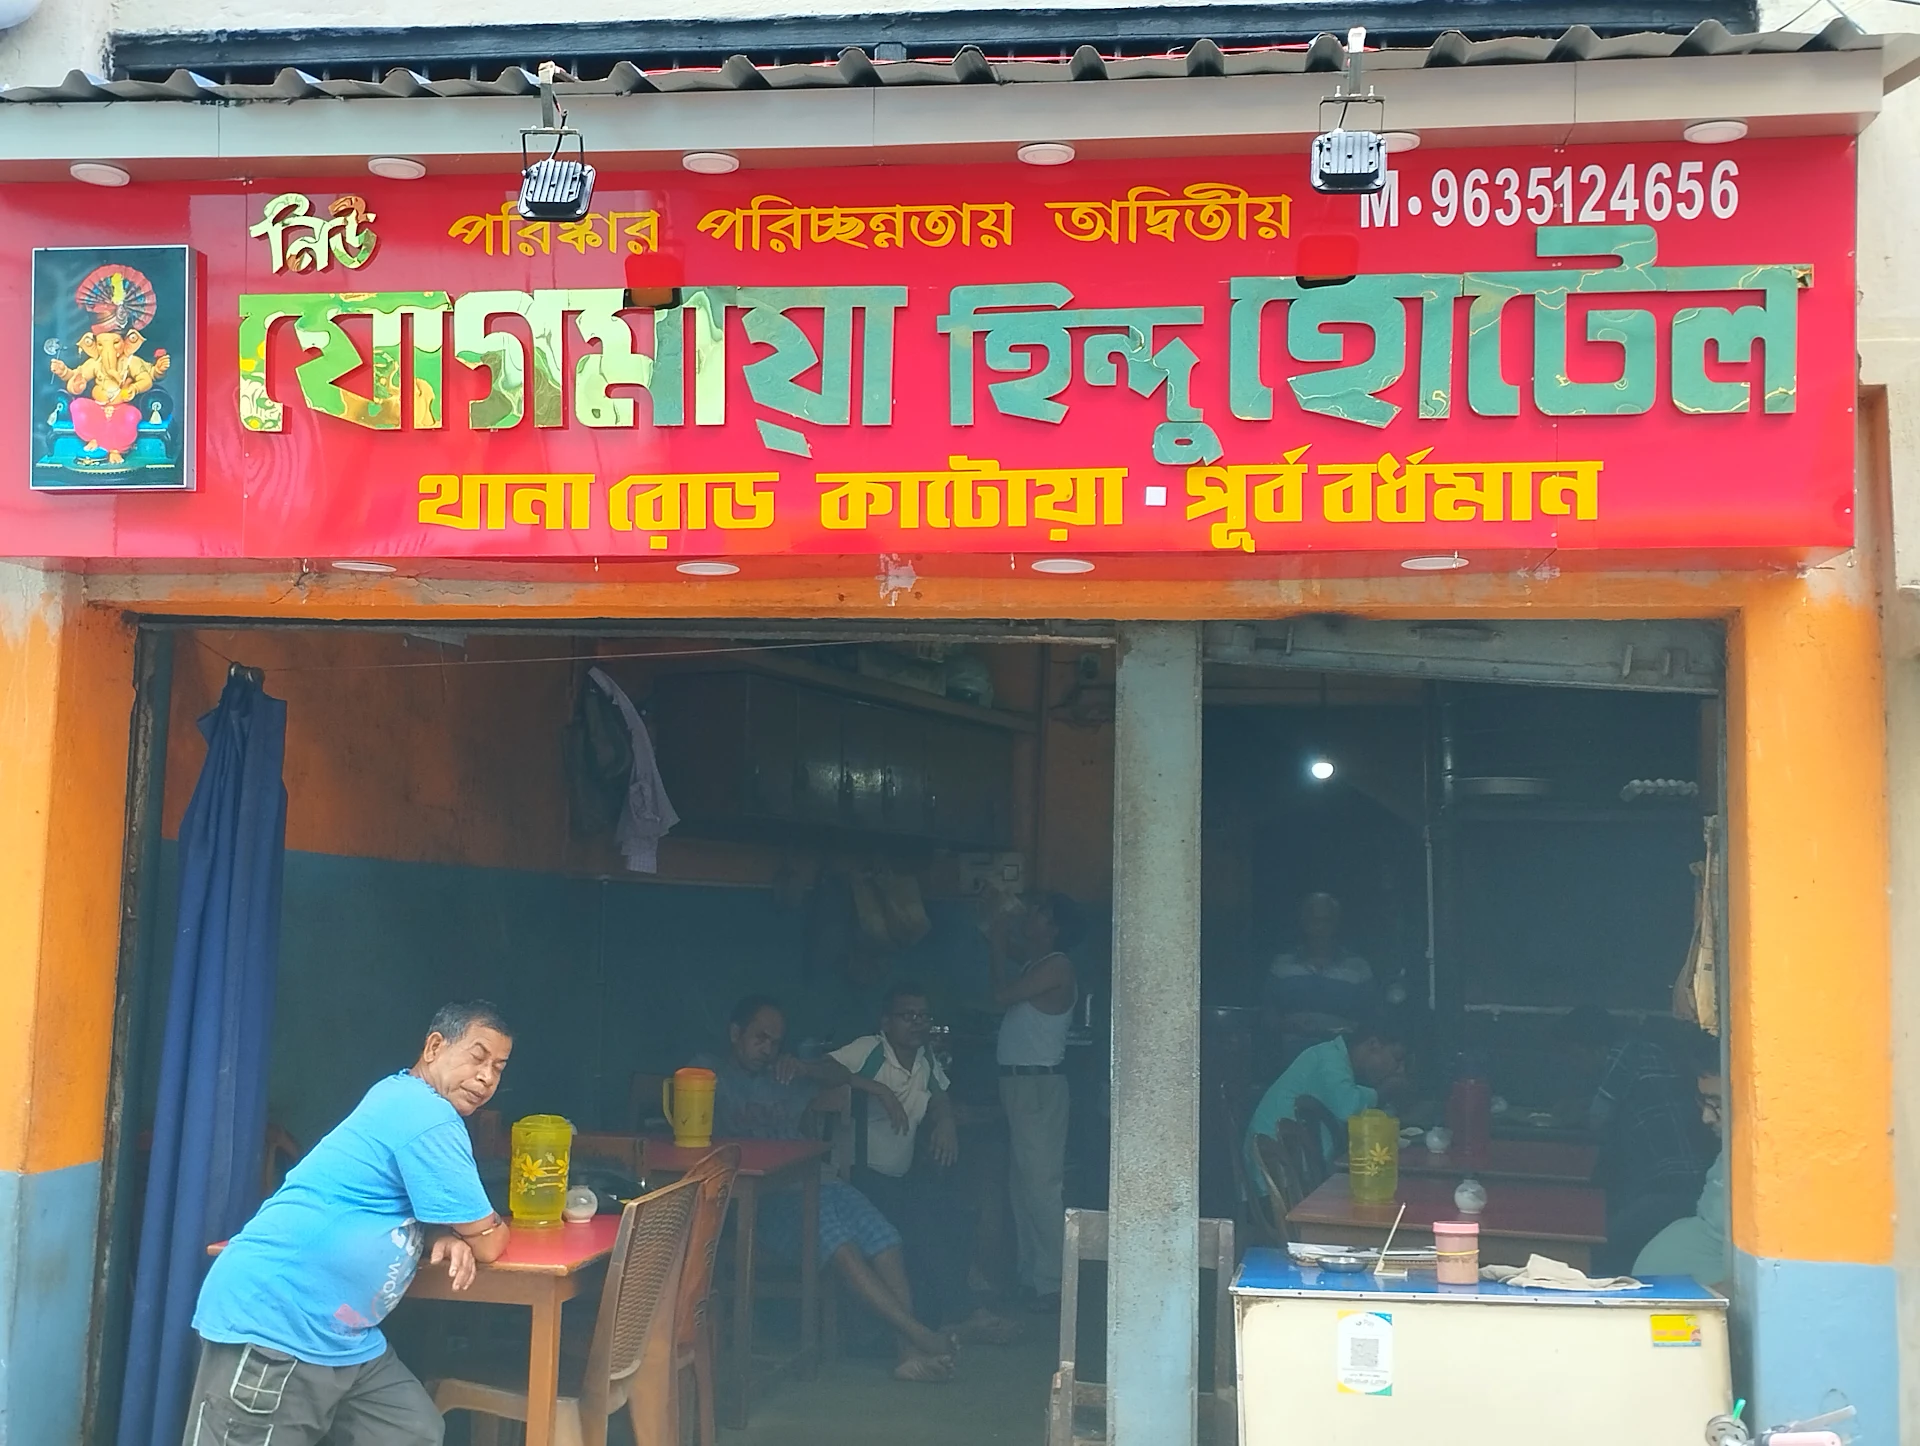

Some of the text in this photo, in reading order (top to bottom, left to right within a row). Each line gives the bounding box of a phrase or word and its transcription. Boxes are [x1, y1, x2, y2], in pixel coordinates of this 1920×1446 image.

[249, 193, 377, 274] নিউ
[697, 194, 1015, 253] পরিচ্ছন্নতায়
[1044, 182, 1293, 244] অদ্বিতীয়
[239, 224, 1813, 465] যোগমায়া হিন্দু হোটেল
[418, 443, 1604, 553] থানা রোড কাটোয়া পূর্ব বর্ধমান
